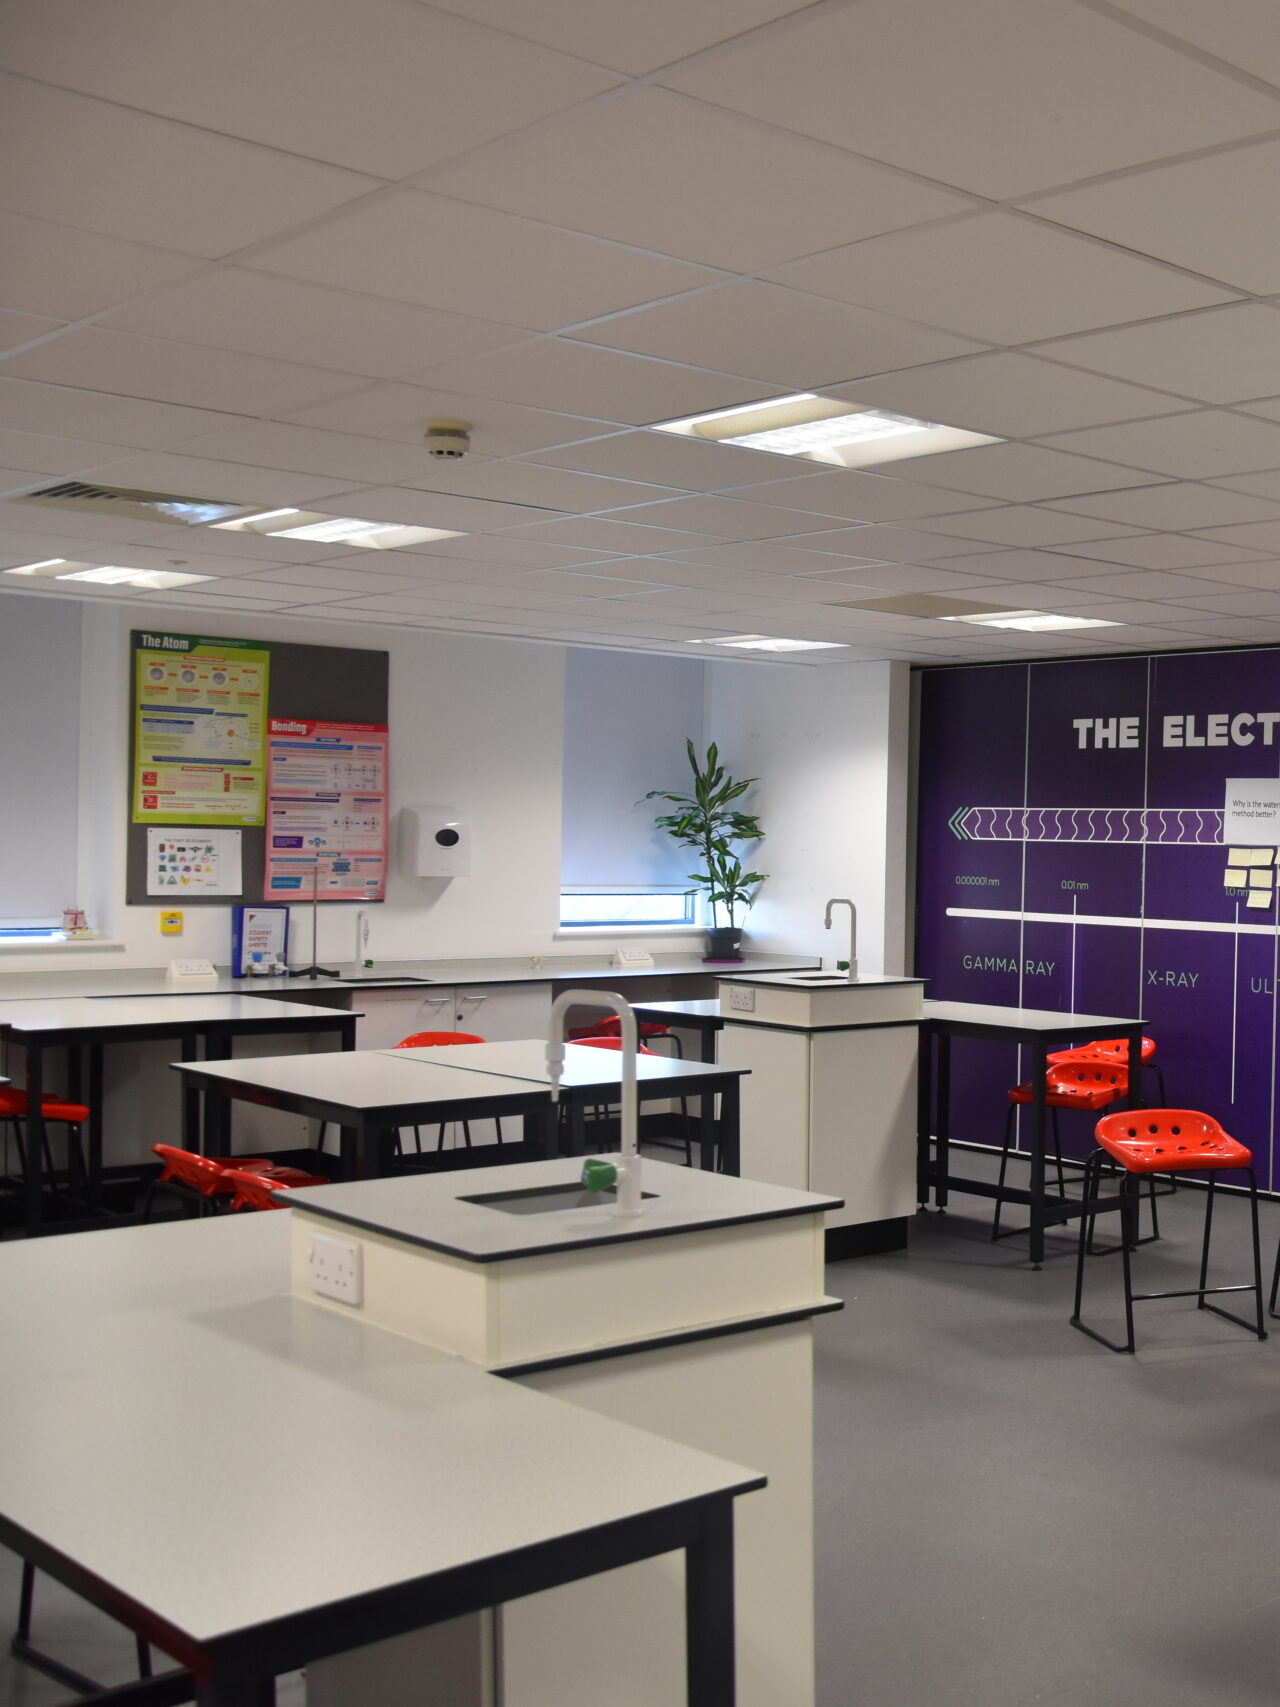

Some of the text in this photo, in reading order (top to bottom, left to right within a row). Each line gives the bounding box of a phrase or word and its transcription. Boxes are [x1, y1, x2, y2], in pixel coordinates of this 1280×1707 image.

[142, 634, 161, 647] The
[162, 637, 189, 650] Atom
[272, 721, 307, 735] Bonding
[1073, 717, 1139, 749] THE
[1232, 799, 1245, 808] Why
[1253, 800, 1262, 808] the
[1256, 810, 1277, 818] better?
[988, 878, 1000, 886] nm
[1061, 879, 1089, 890] 0.01 nm
[963, 955, 1055, 976] GAMMA RAY
[1148, 970, 1199, 988] X-RAY
